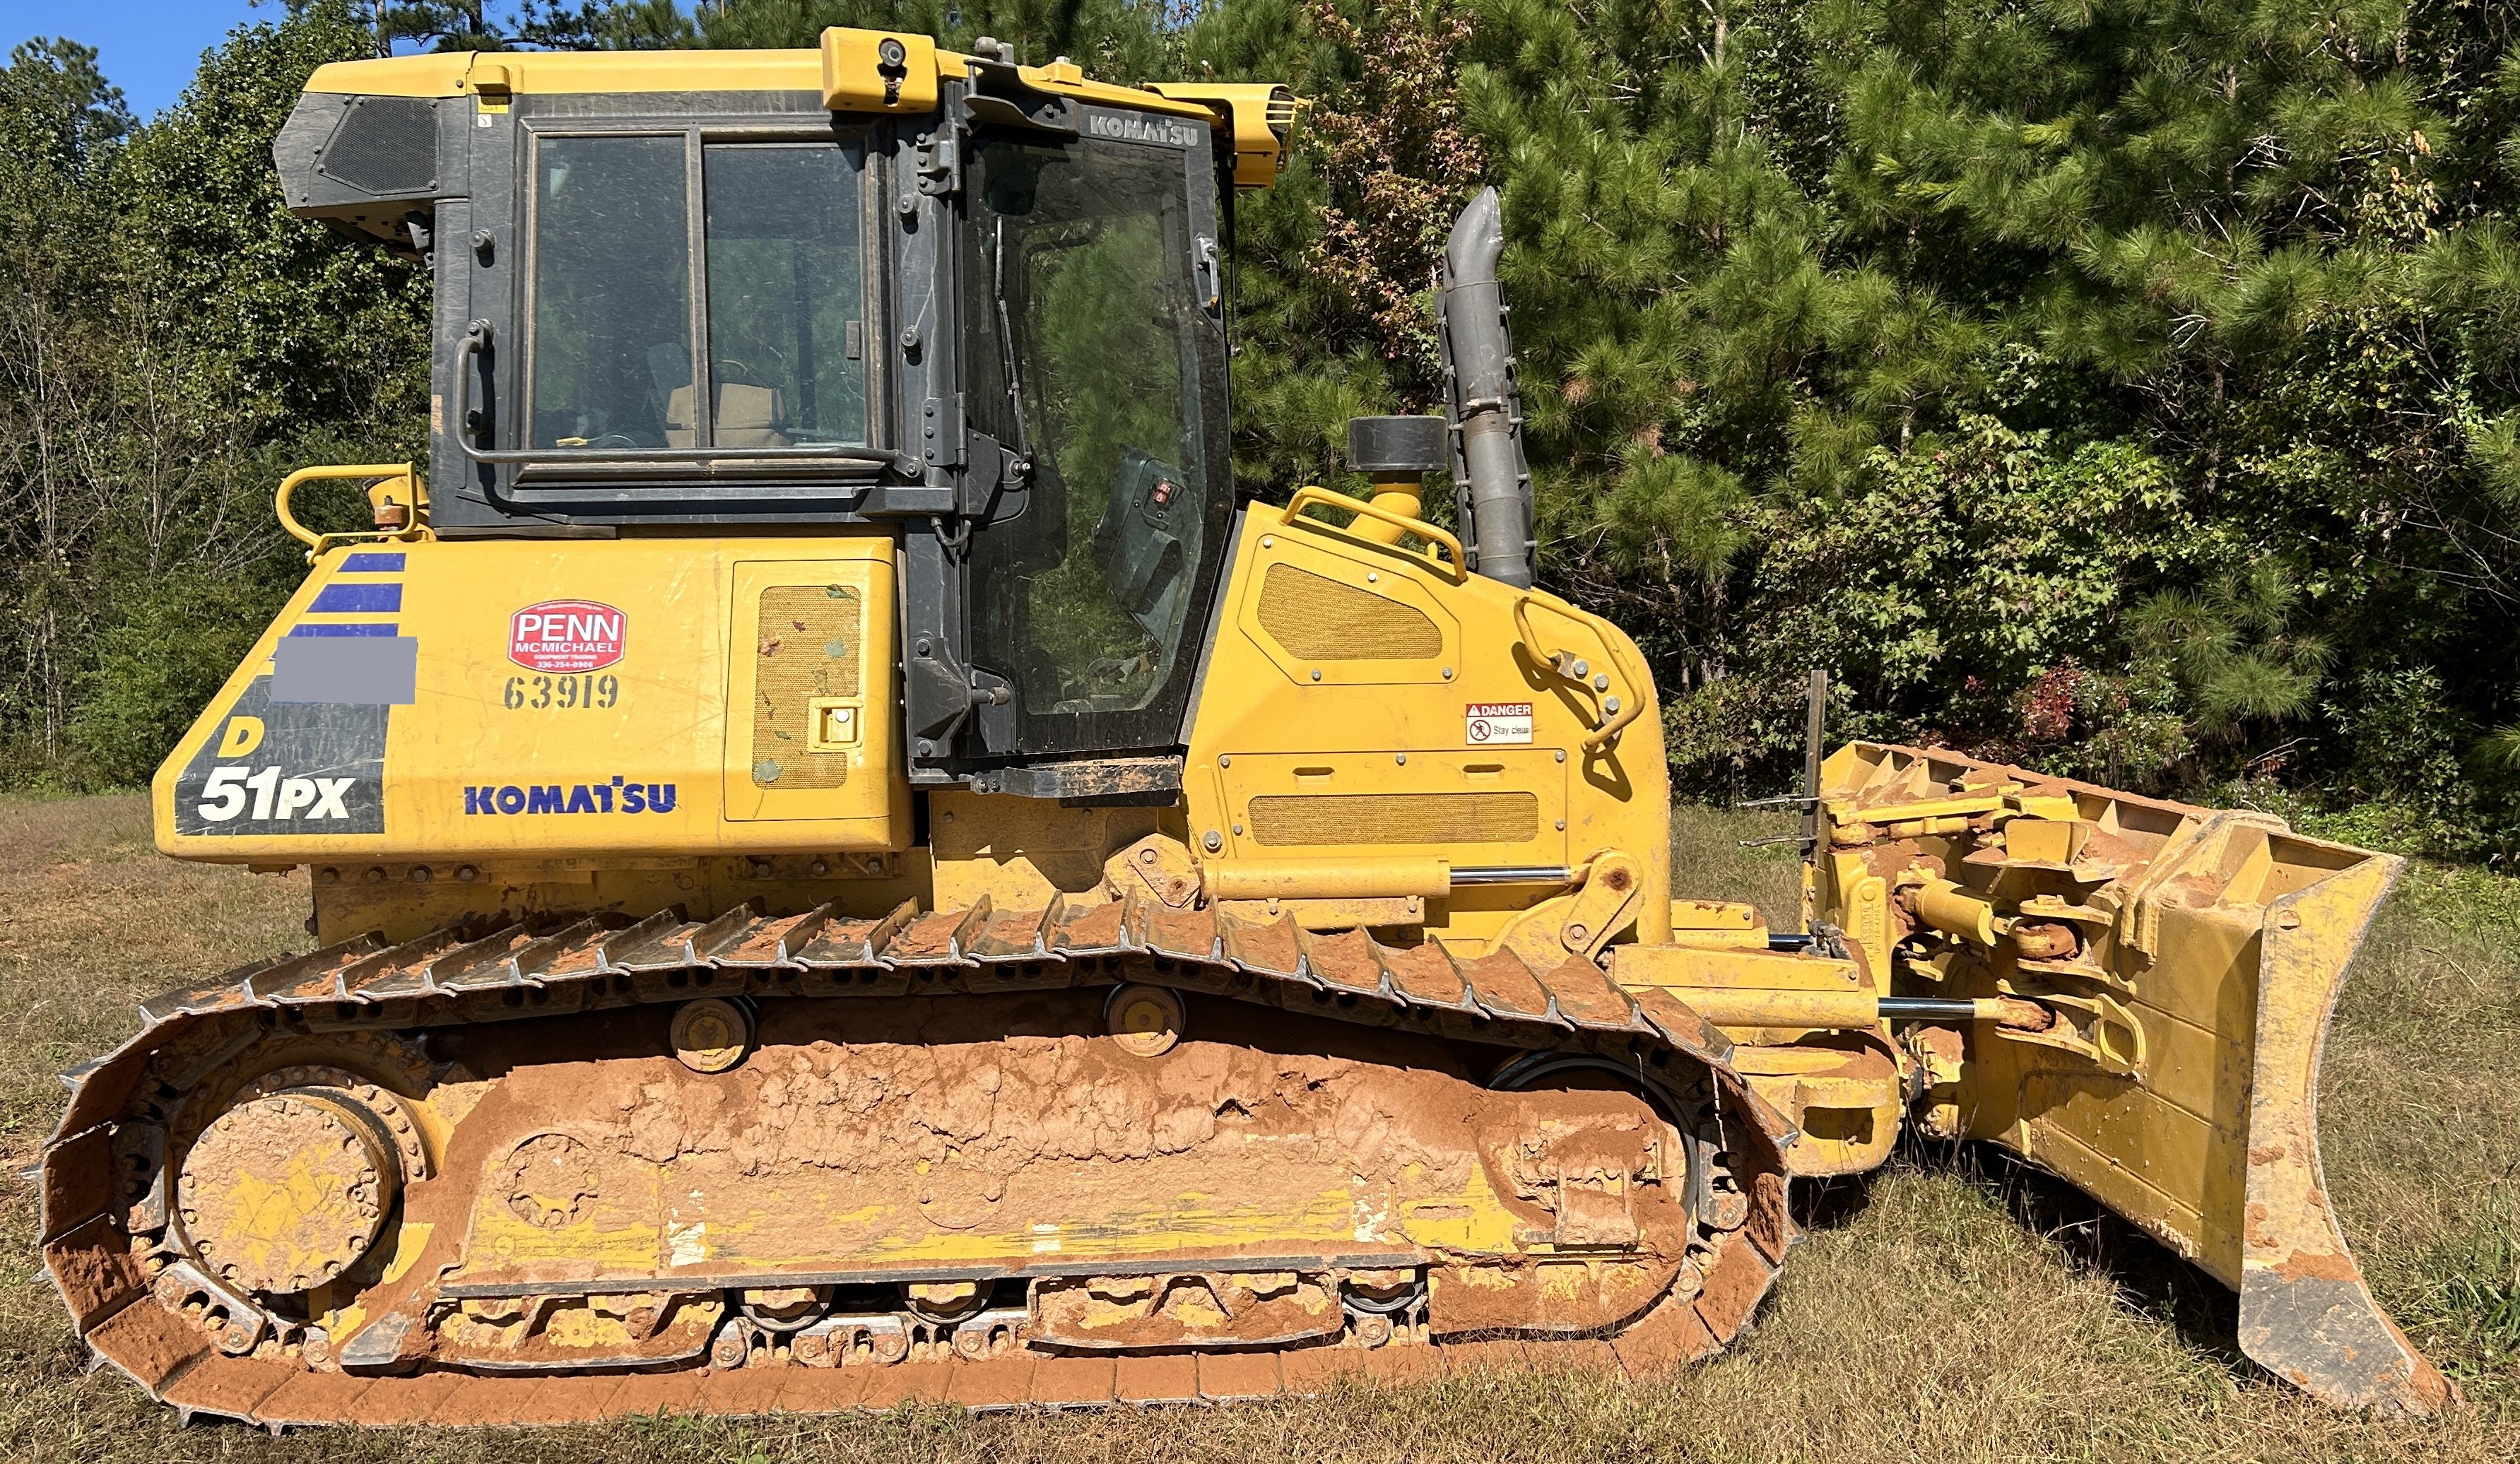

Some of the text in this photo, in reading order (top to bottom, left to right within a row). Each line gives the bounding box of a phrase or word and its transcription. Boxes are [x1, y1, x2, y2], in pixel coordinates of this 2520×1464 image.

[1090, 114, 1199, 147] KOMATSU
[517, 613, 620, 642] PENN
[514, 642, 618, 654] MCMICHAEL
[504, 674, 619, 710] 63919
[1480, 704, 1532, 716] DANGER
[217, 716, 266, 758] D
[1493, 725, 1509, 737] Stay
[197, 765, 357, 822] 51PX
[464, 775, 677, 815] KOMATSU
